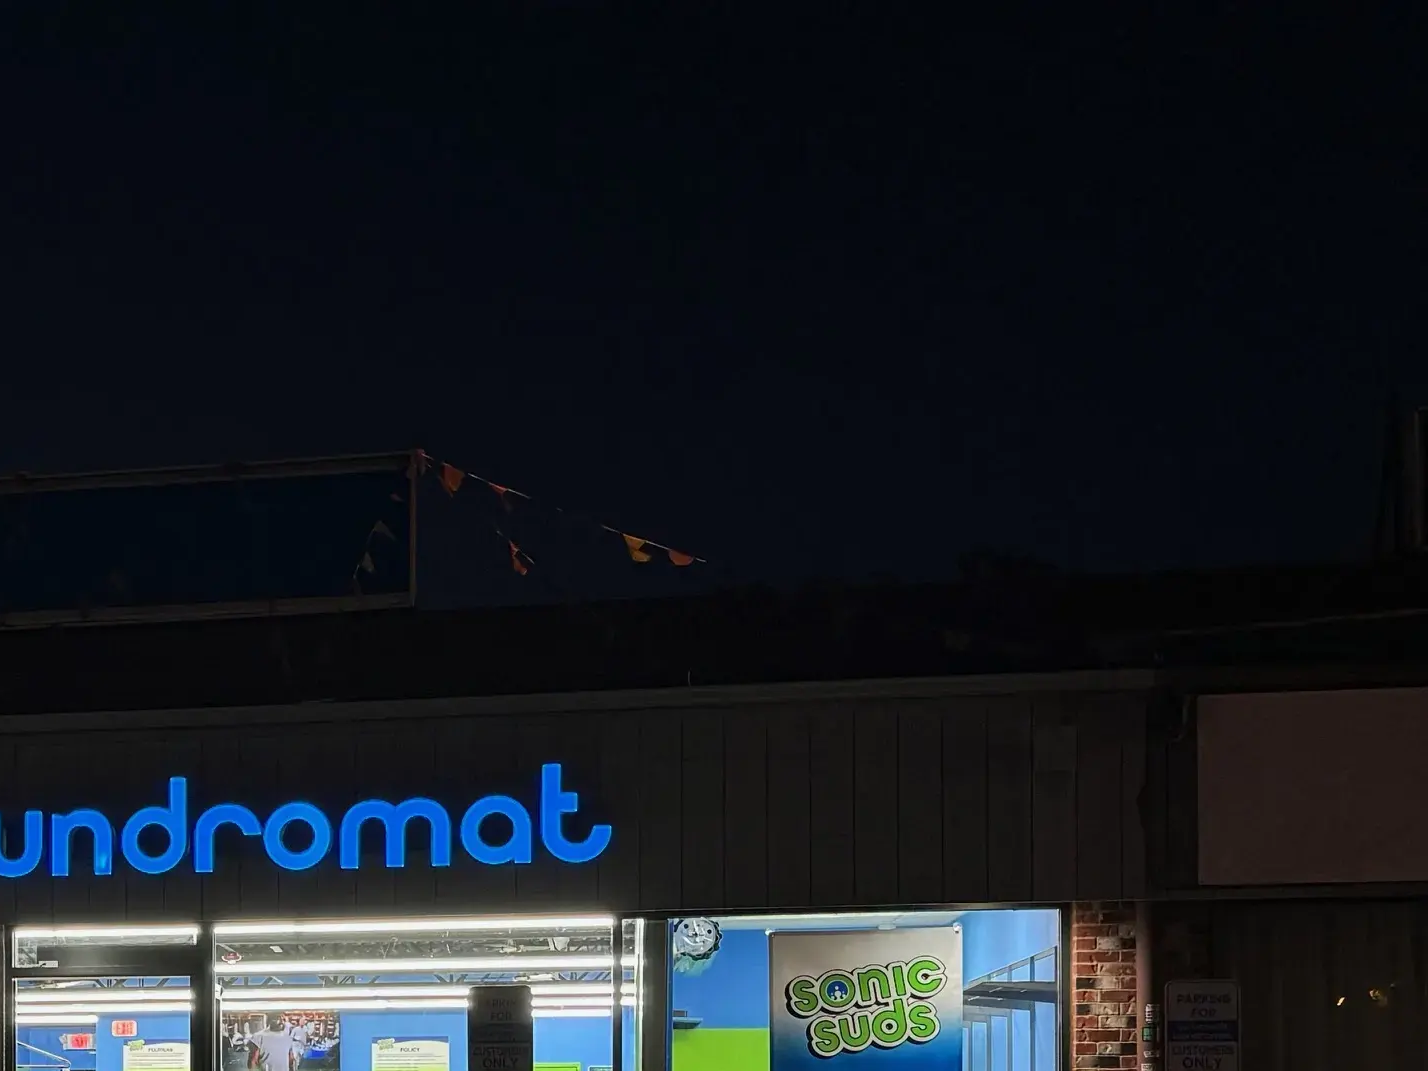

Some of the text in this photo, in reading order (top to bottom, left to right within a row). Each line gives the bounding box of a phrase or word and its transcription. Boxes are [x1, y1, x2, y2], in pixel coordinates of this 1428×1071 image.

[1190, 1007, 1217, 1017] FOR
[482, 1058, 518, 1068] ONLY
[1182, 1057, 1222, 1069] ONLY
